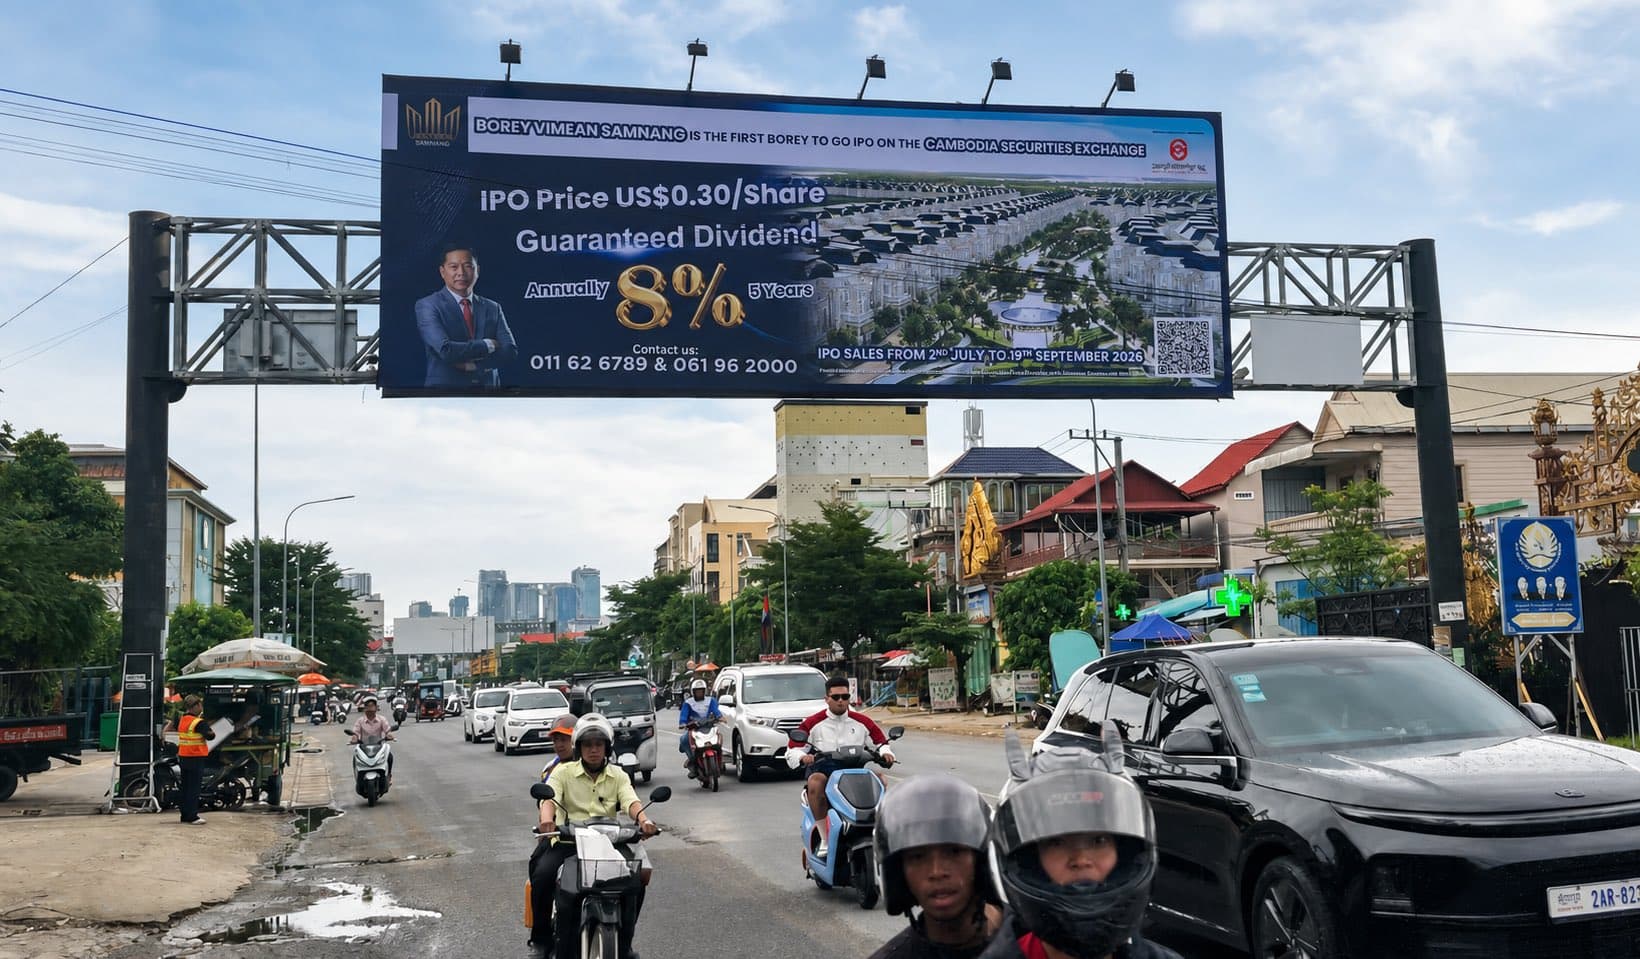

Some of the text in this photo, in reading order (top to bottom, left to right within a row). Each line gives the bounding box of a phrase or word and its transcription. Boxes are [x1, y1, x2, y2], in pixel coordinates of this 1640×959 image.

[475, 118, 1146, 158] BOREY VIMEAN SAMNANG IS THE FIRST BOREY TO GO IPO ON THE CAMBODIA SECURITIES EXCHANGE
[480, 177, 826, 211] IPO Price US$0.30/Share
[515, 220, 818, 253] Guaranteed Dividend
[524, 262, 815, 330] Annually 8% 5 Years
[530, 355, 798, 374] 011 62 6789 & 061 96 2000
[632, 343, 700, 356] Contact us:
[817, 347, 1144, 363] IPO SALES FROM 2ND JULY TO 19TH SEPTEMBER 2026
